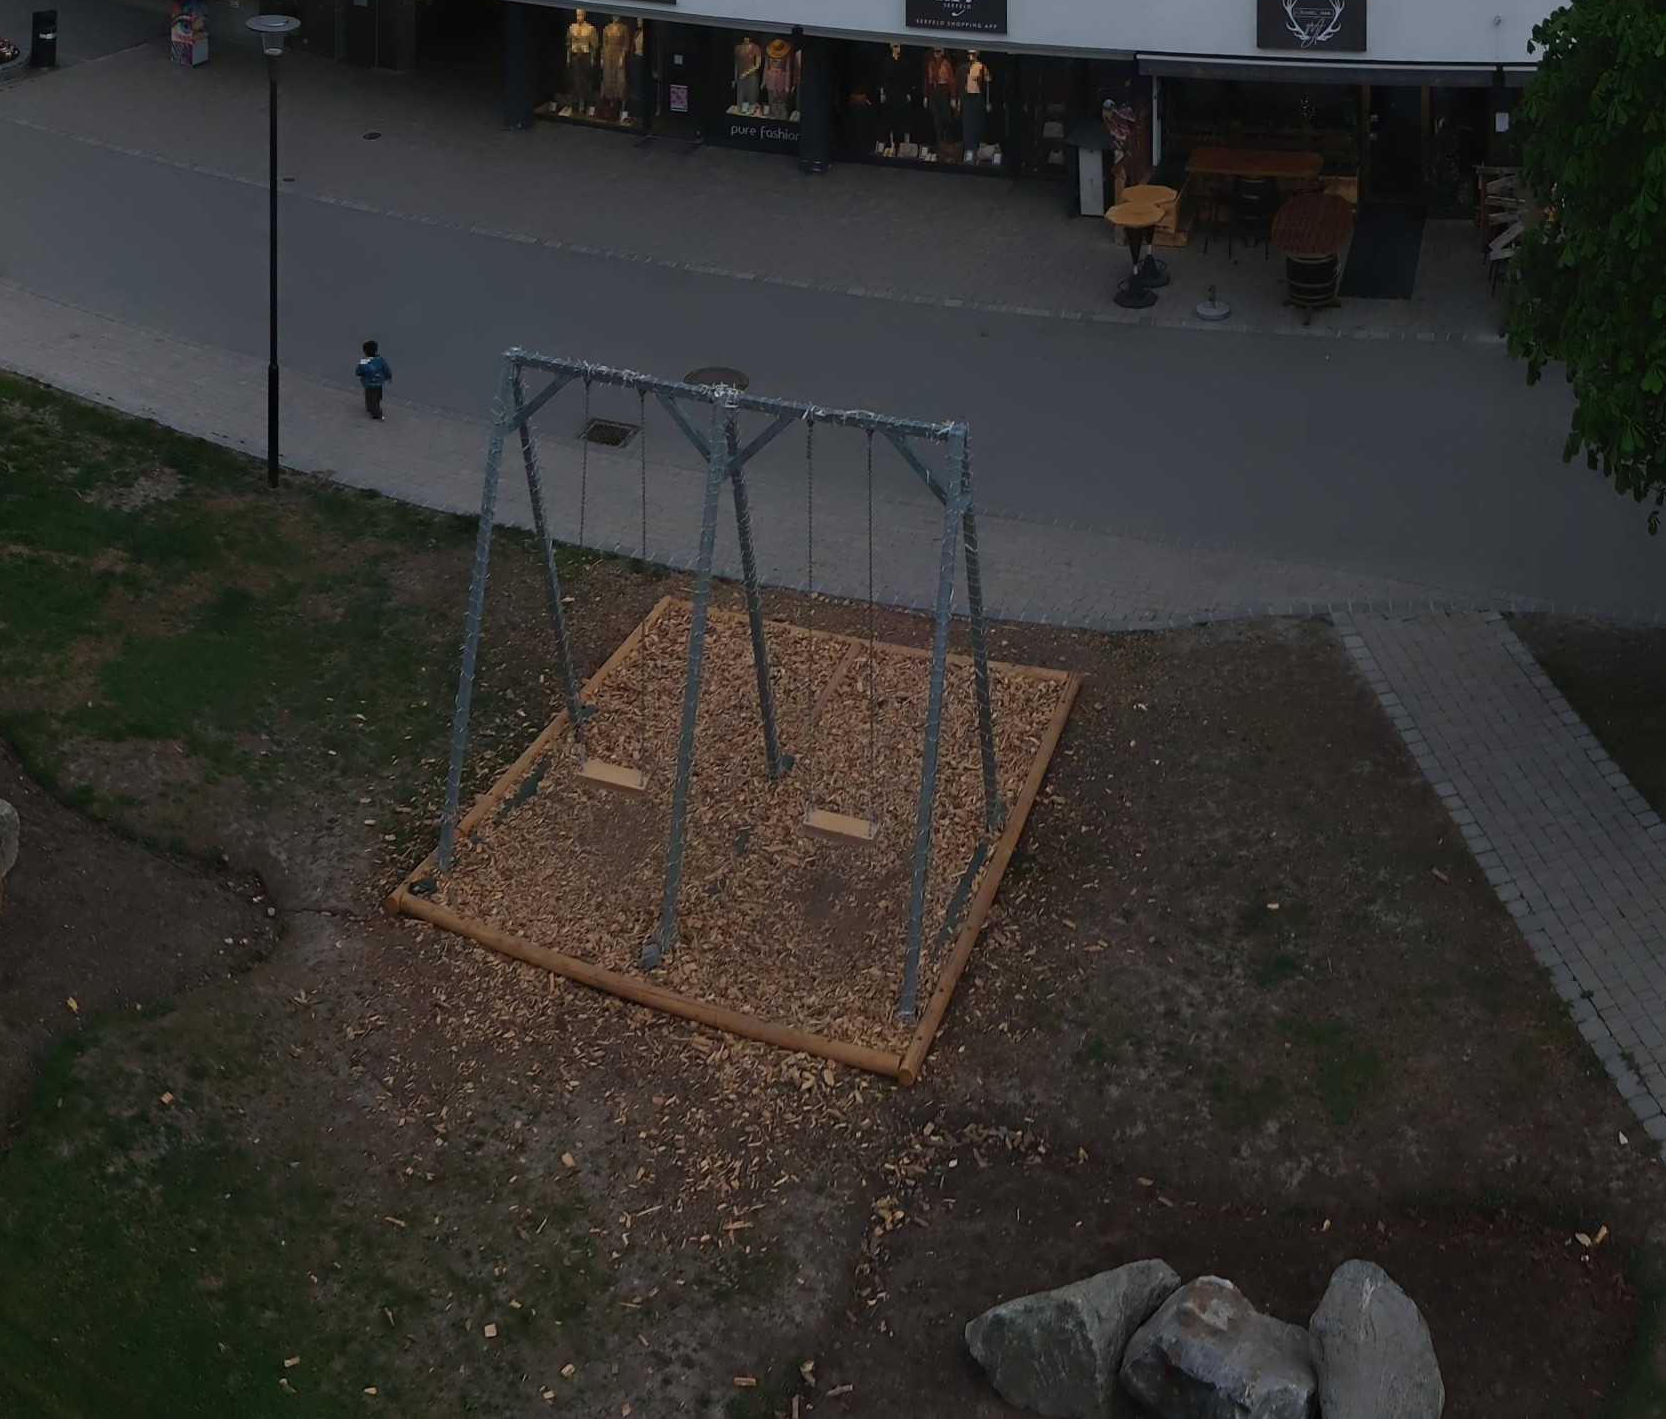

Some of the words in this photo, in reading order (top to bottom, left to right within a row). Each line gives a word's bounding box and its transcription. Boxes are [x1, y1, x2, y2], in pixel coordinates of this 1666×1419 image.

[943, 2, 972, 10] SEEFELD
[916, 18, 944, 26] SEEFELD
[947, 20, 982, 29] SHOPPING
[730, 124, 757, 136] pure
